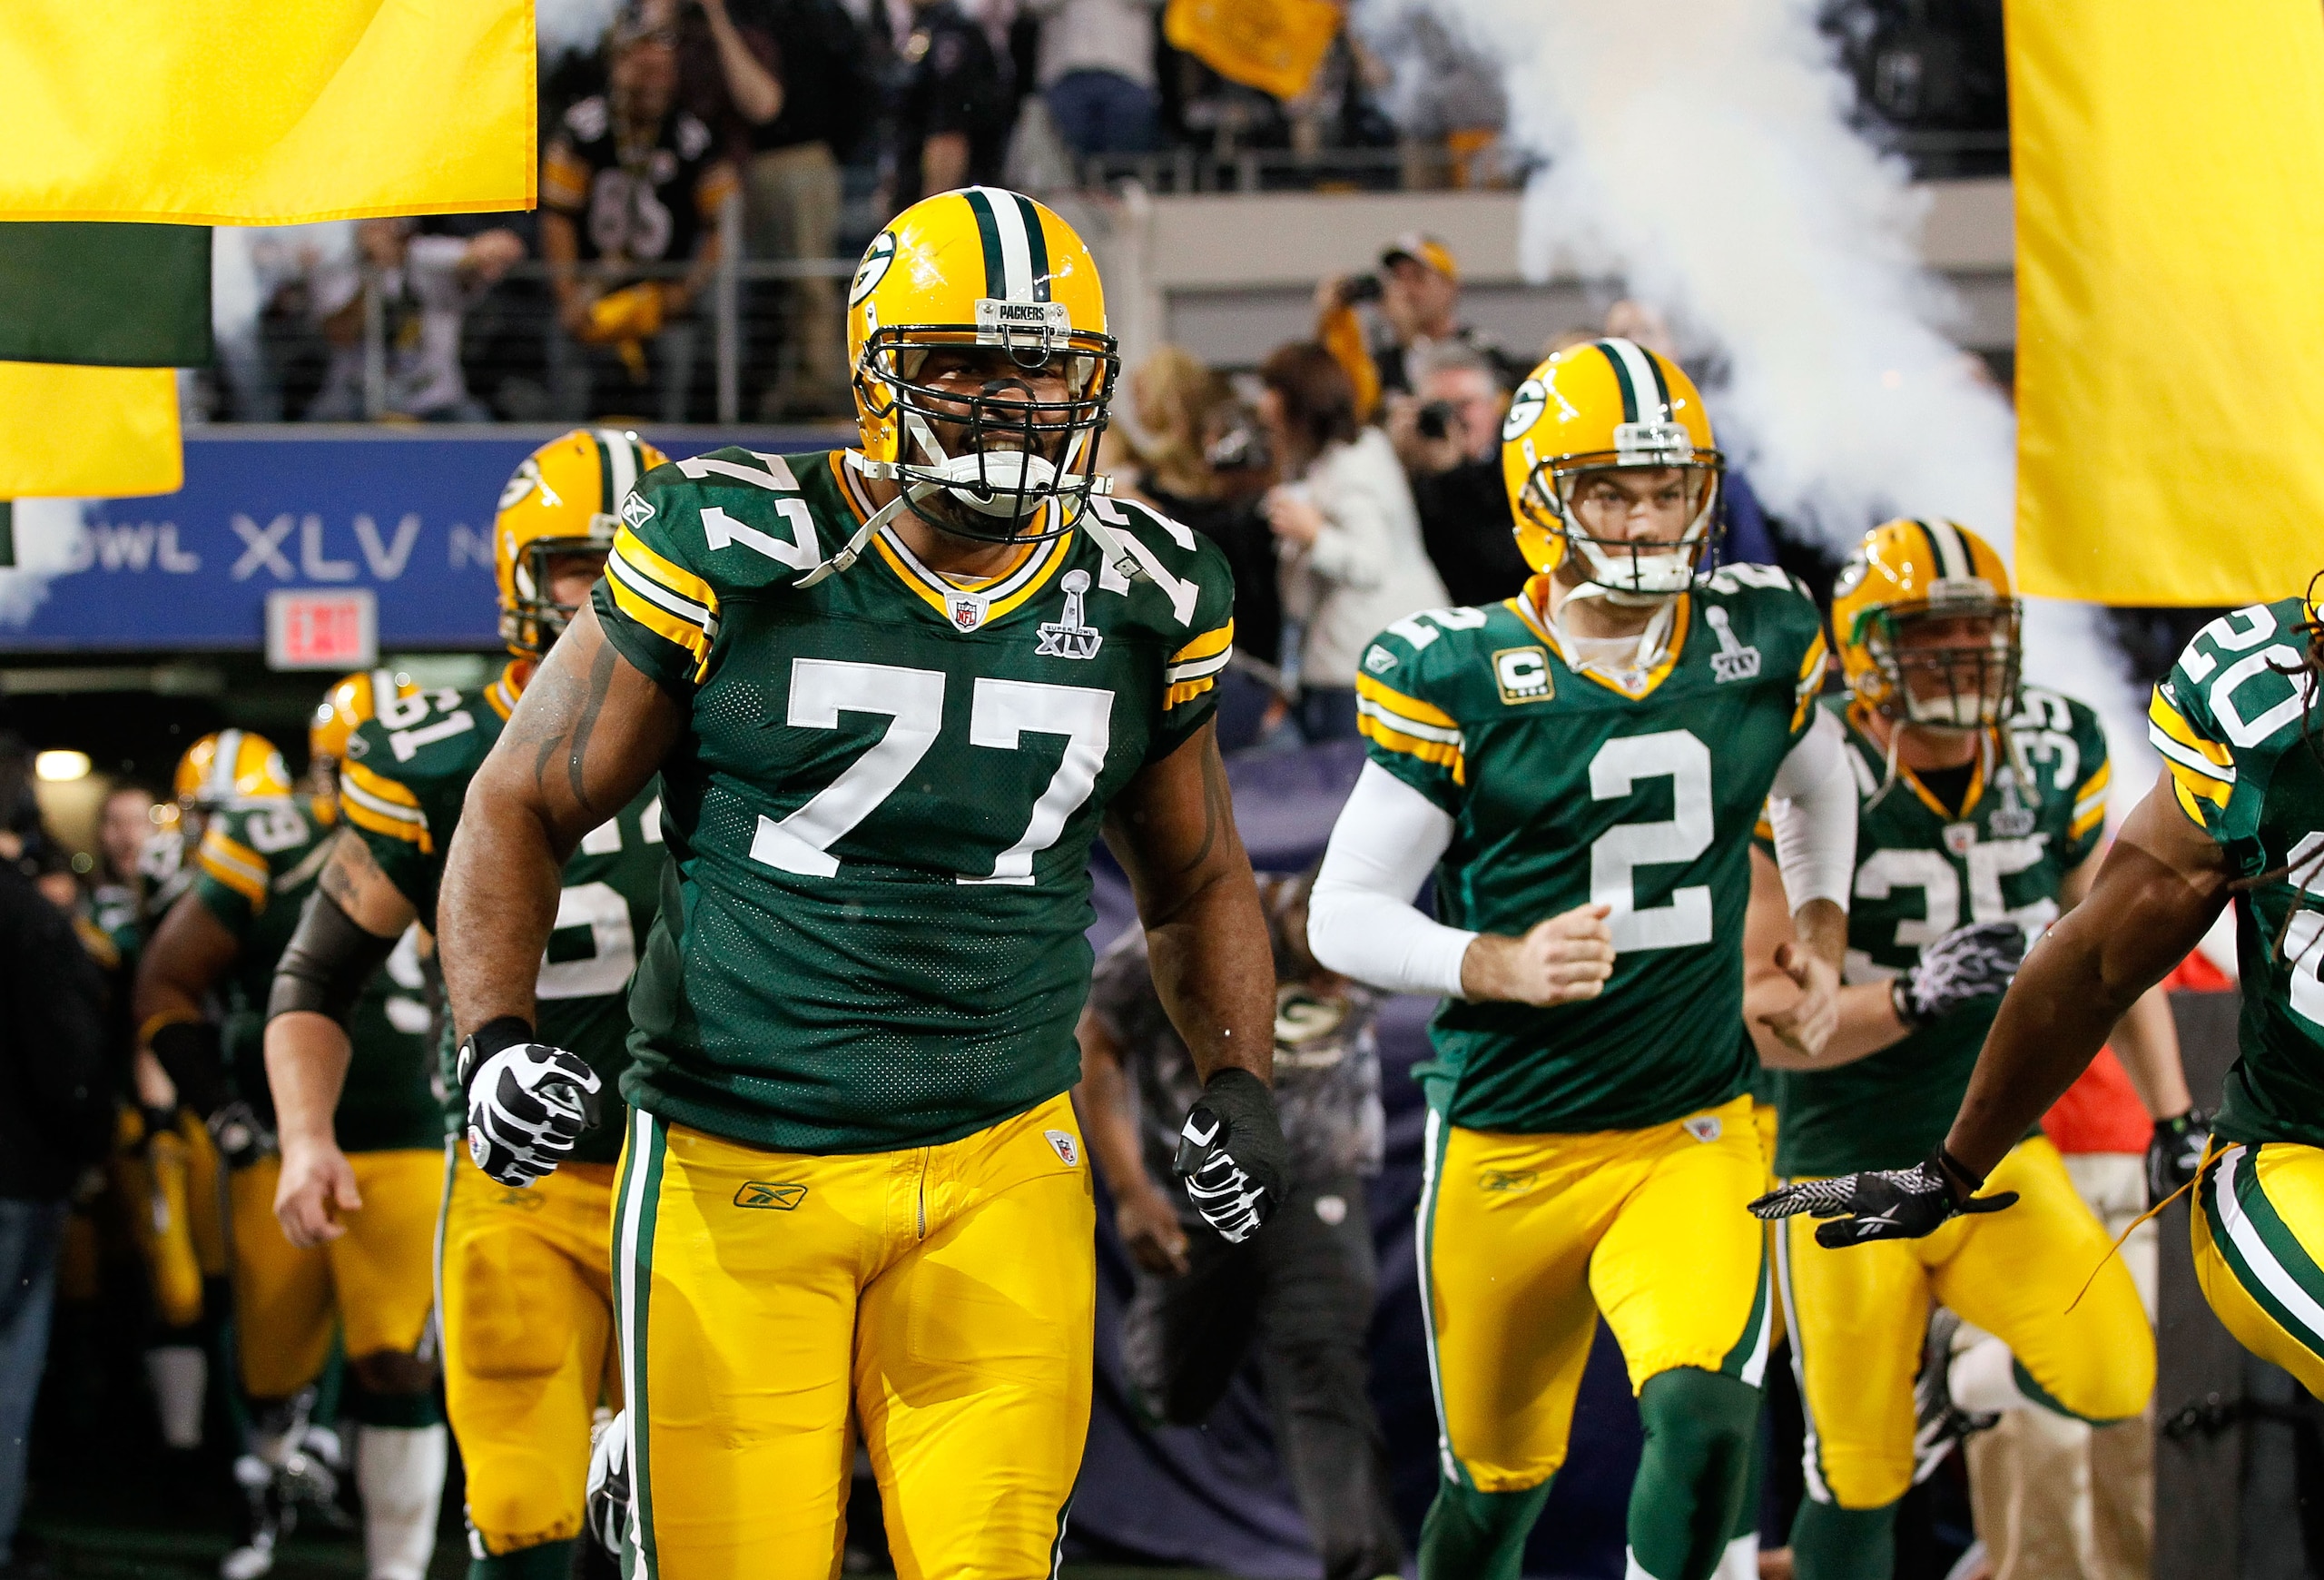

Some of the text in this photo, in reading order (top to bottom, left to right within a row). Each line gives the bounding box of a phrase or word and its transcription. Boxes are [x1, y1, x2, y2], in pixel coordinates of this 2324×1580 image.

[1000, 304, 1045, 321] PACKERS
[69, 521, 202, 575] OWL
[230, 512, 423, 581] XLV
[675, 450, 820, 572] 77
[1089, 494, 1199, 628] 77
[1035, 630, 1104, 660] XLV
[1386, 607, 1479, 651] 2
[1499, 651, 1546, 690] C
[2178, 603, 2319, 749] 20
[379, 686, 476, 763] 61
[749, 657, 1116, 886] 77
[1588, 728, 1715, 953] 2
